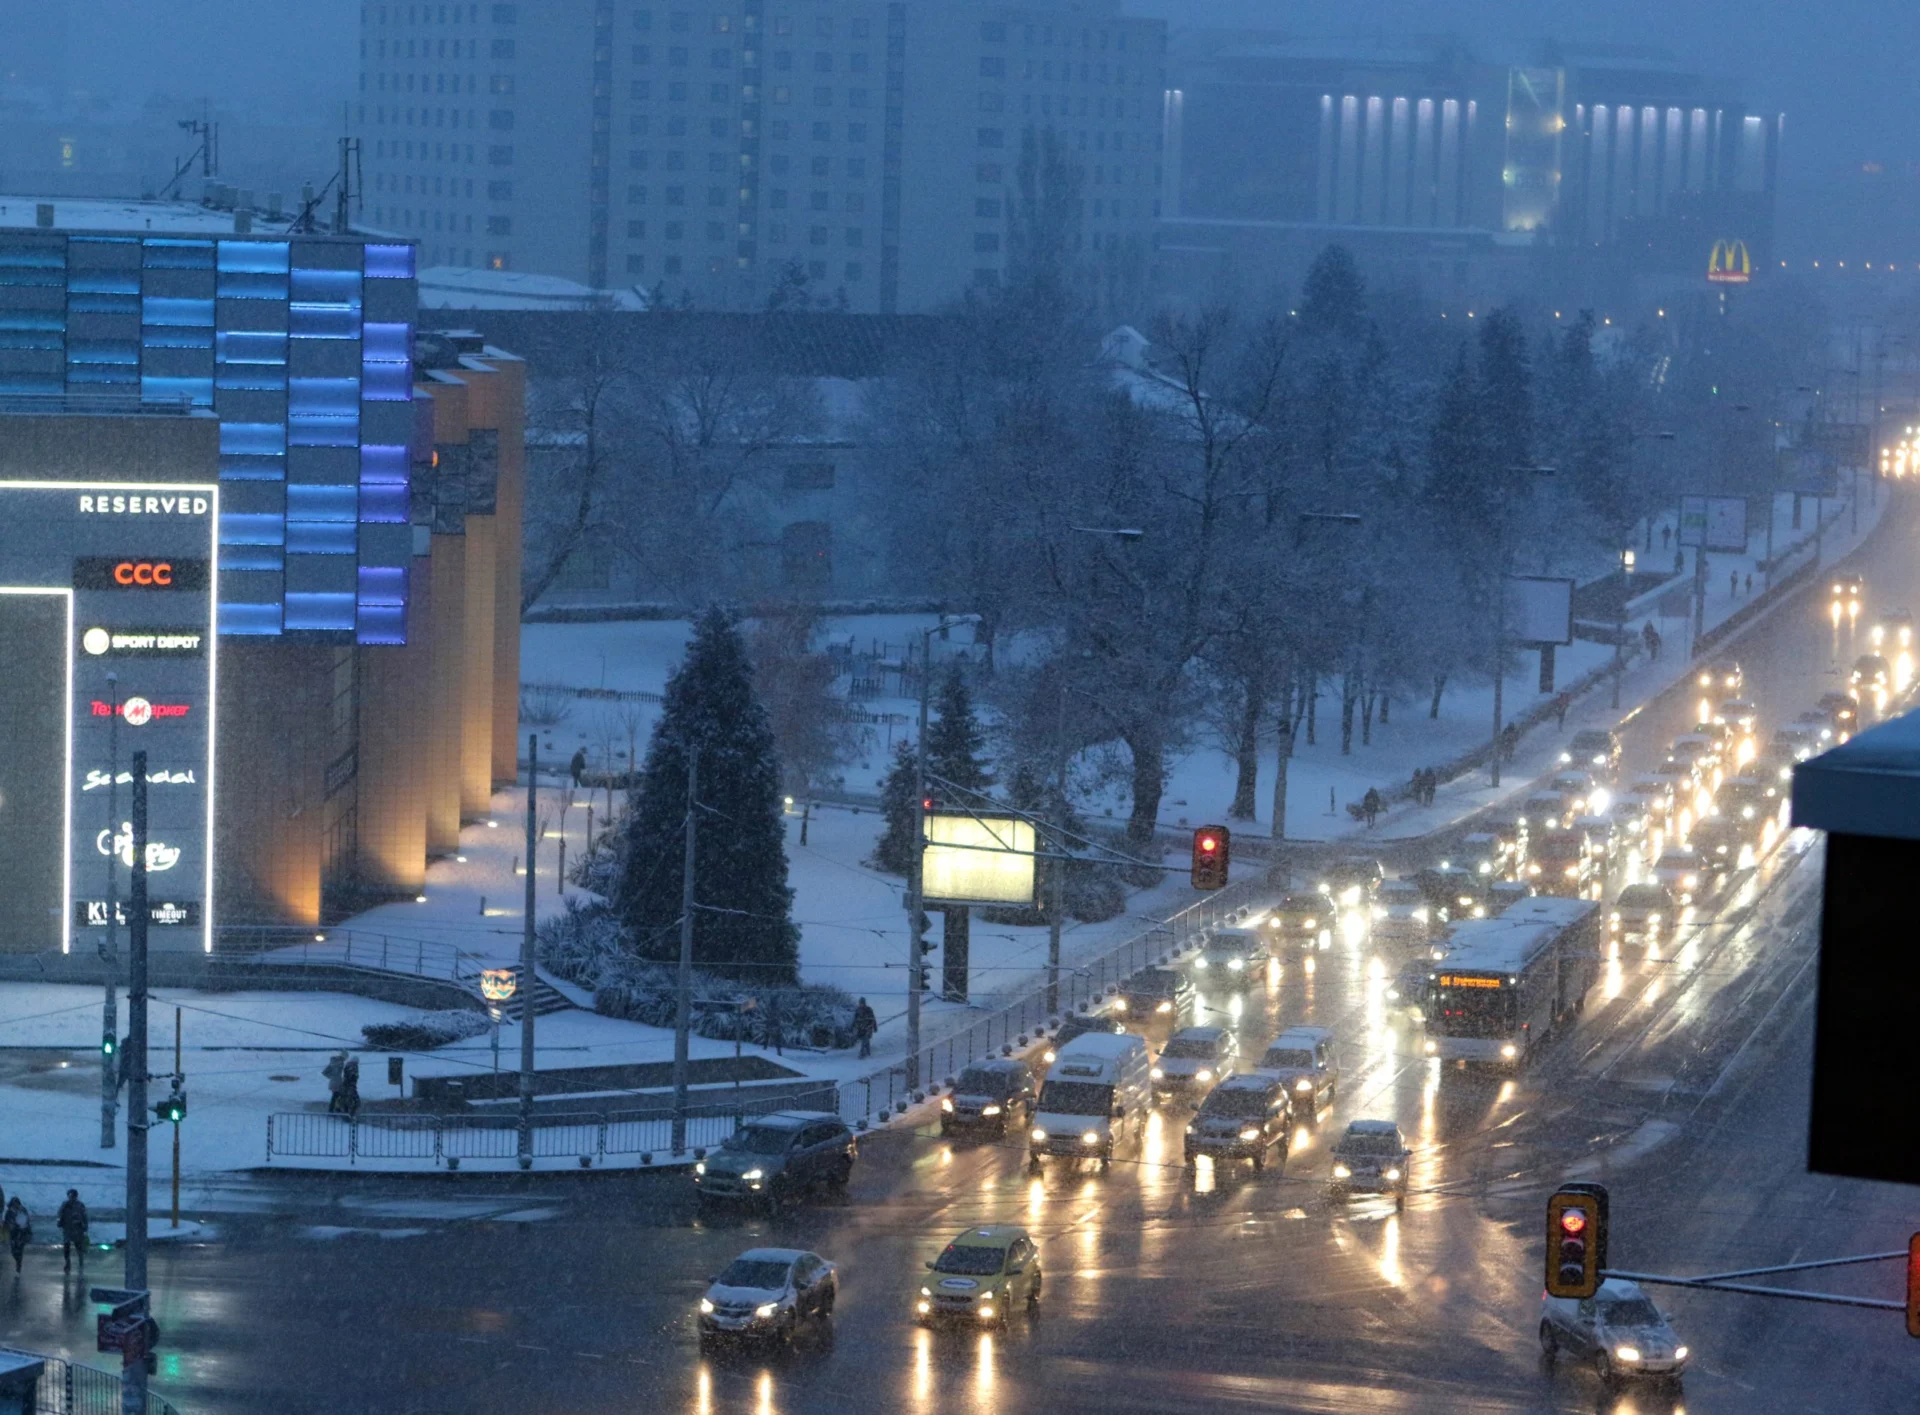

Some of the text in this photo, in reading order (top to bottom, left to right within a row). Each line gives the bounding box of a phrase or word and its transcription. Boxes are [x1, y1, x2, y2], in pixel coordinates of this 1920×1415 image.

[79, 495, 209, 516] RESERVED
[113, 563, 173, 586] CCC
[112, 634, 201, 648] SPORT DEPOT
